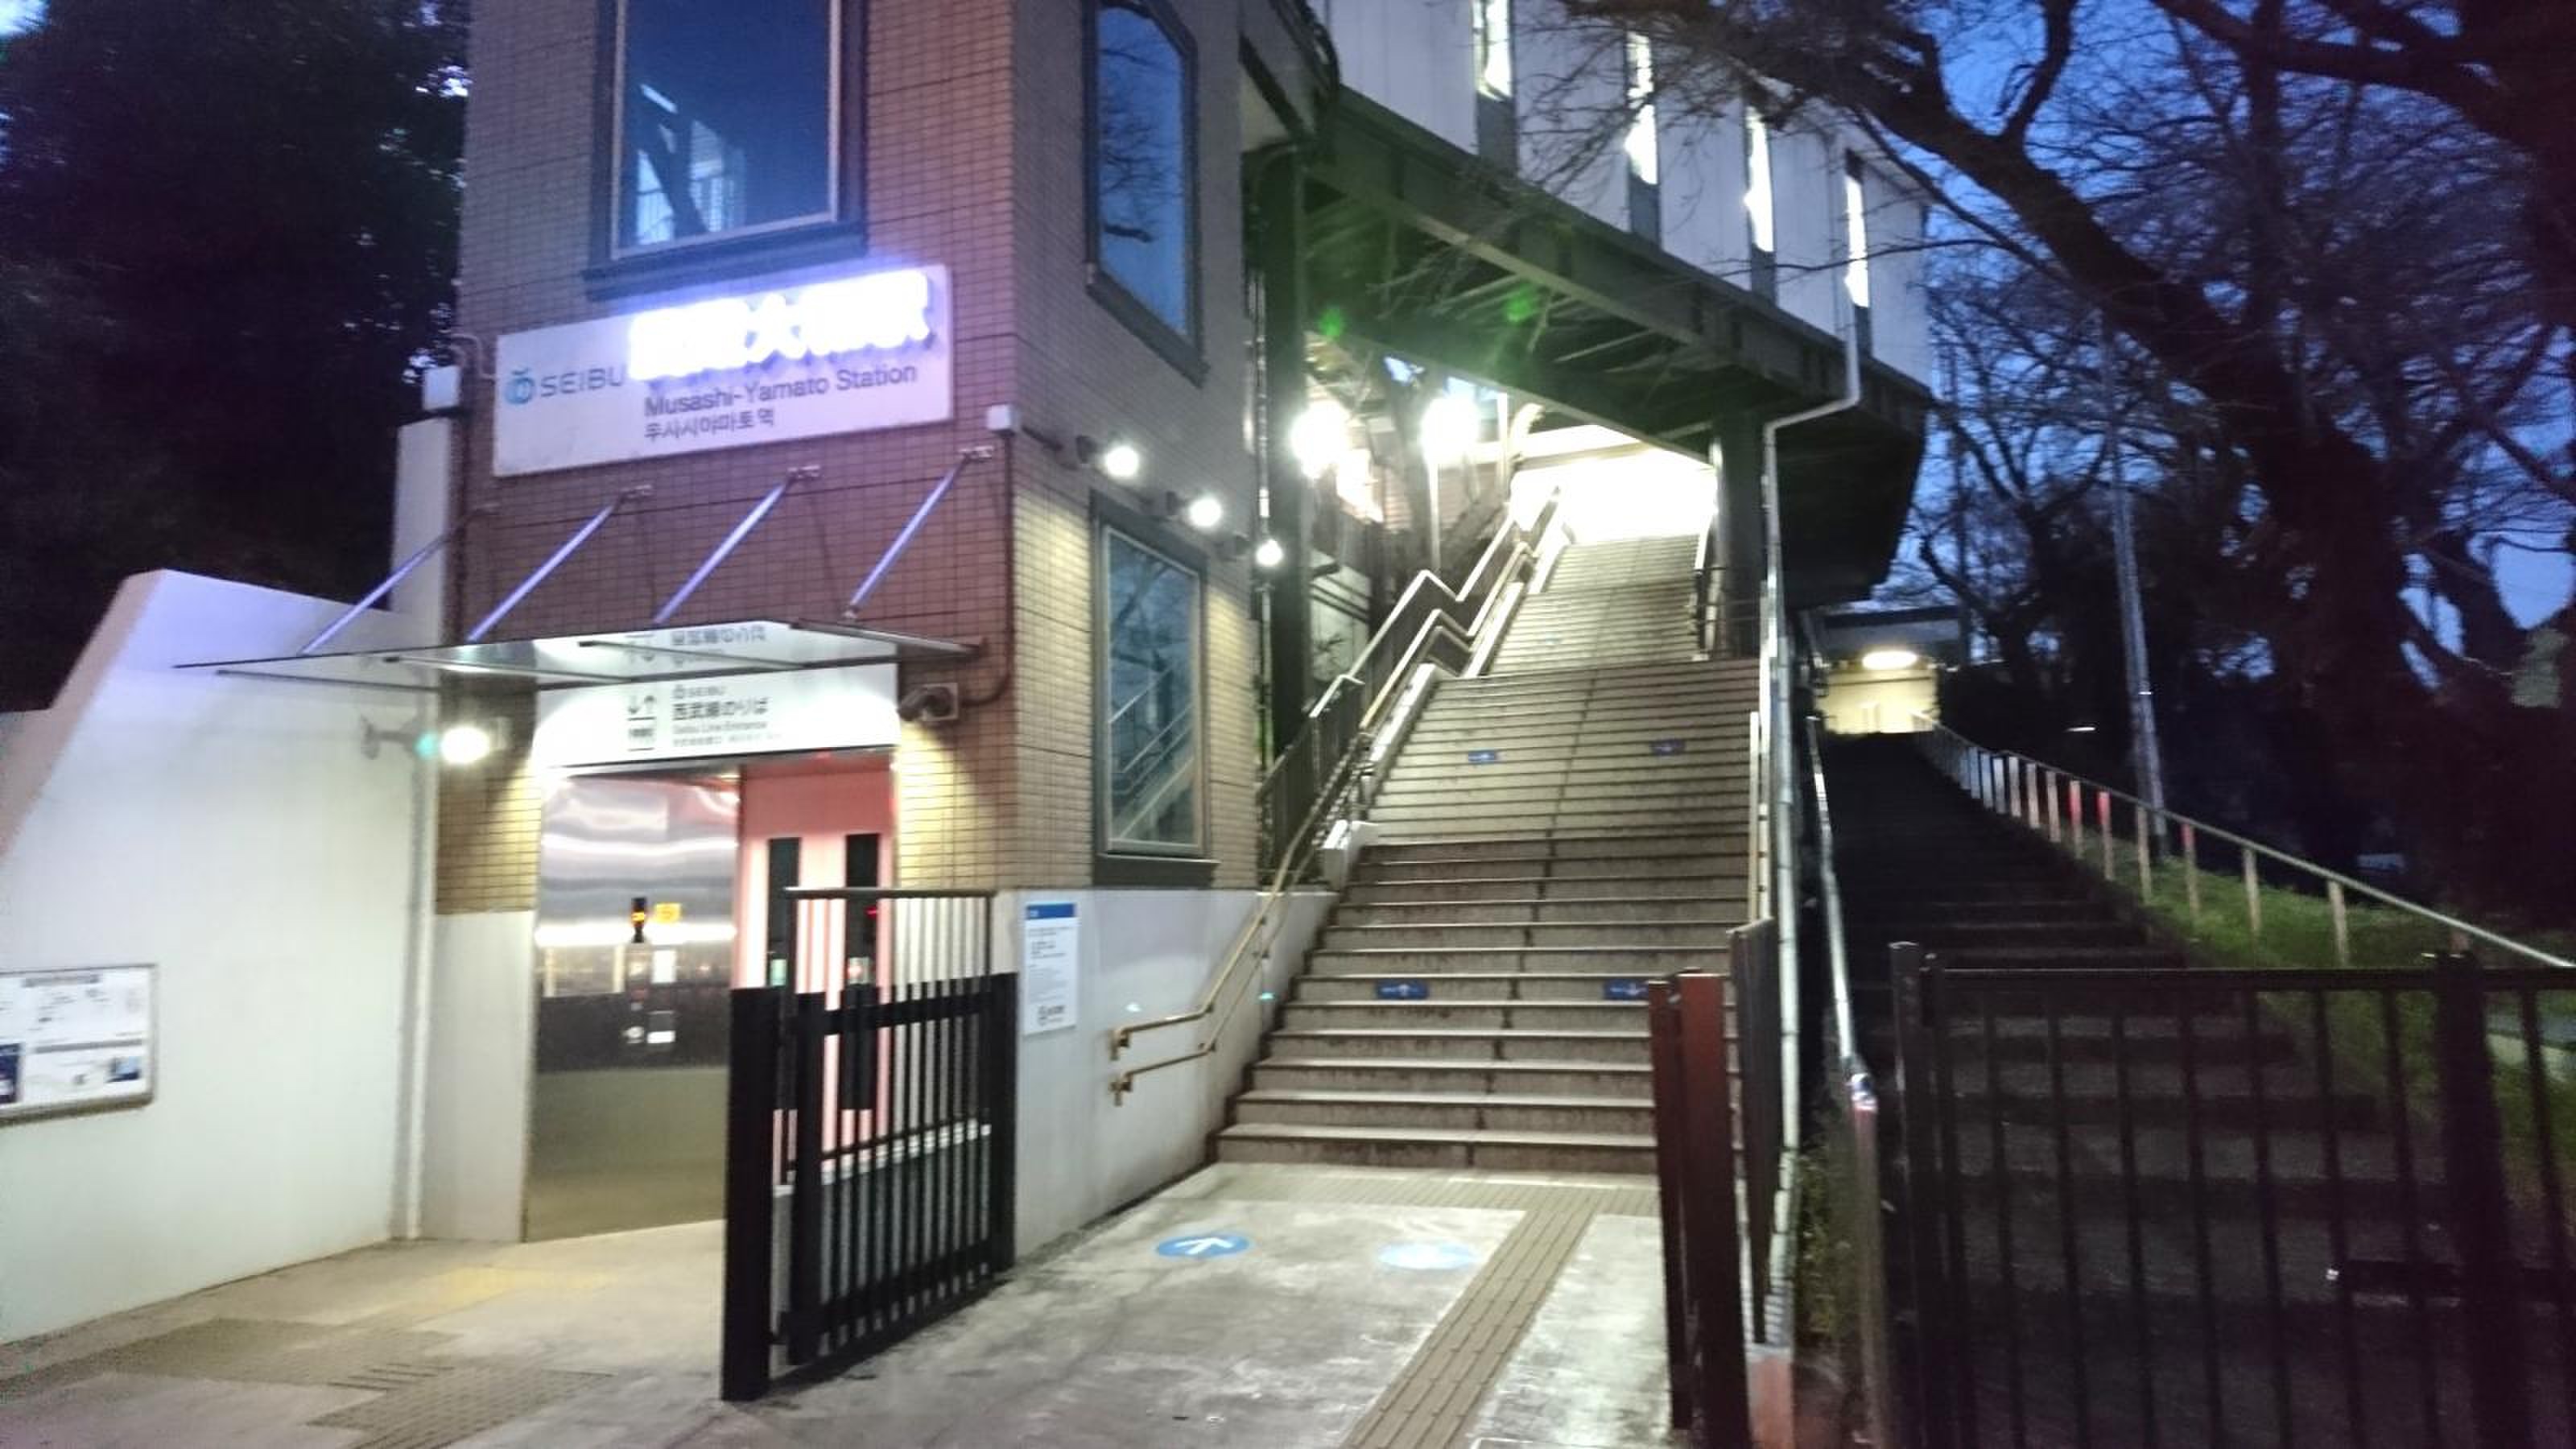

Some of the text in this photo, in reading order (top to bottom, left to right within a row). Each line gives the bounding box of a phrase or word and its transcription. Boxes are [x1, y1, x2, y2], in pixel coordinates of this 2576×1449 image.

[541, 365, 625, 398] SEIBU
[644, 364, 918, 417] Musashi-Yamato Station
